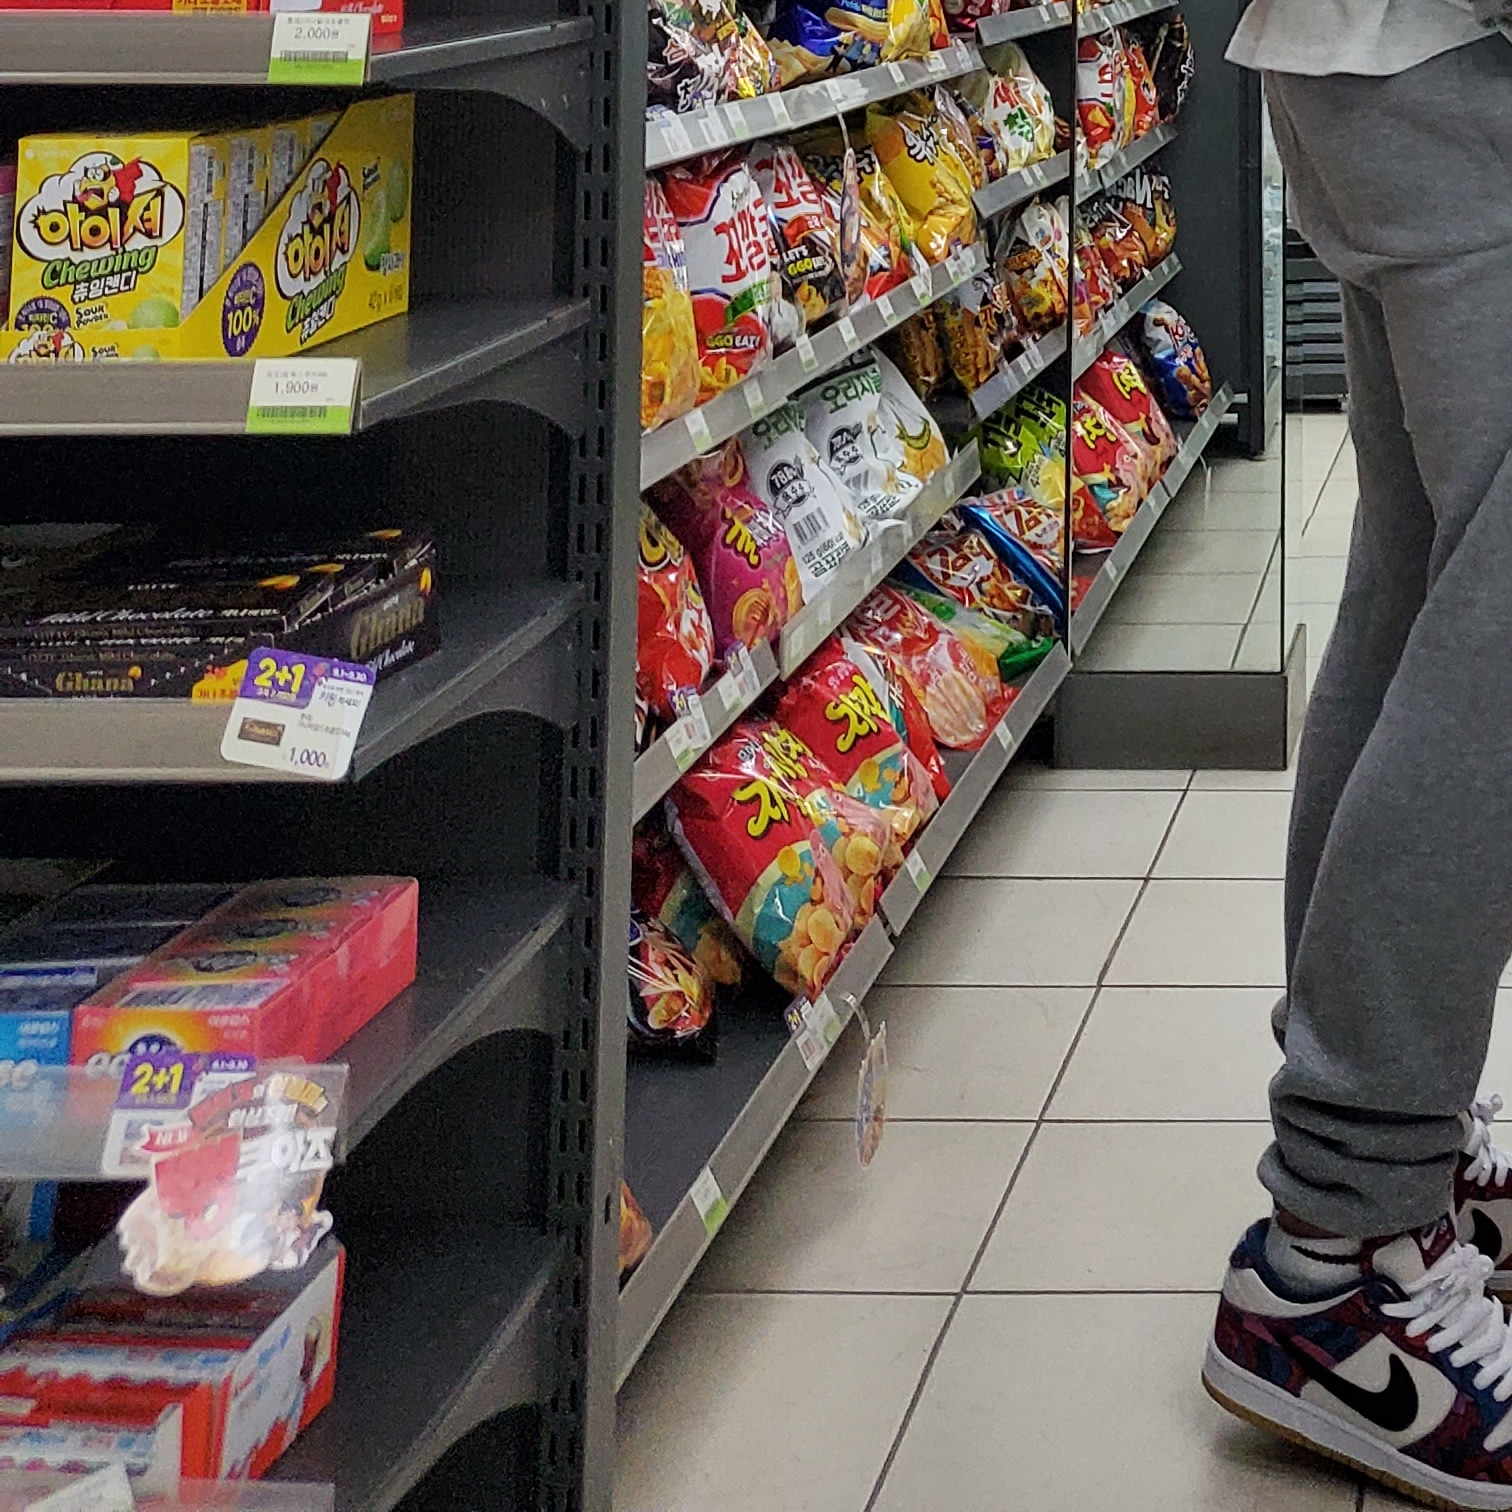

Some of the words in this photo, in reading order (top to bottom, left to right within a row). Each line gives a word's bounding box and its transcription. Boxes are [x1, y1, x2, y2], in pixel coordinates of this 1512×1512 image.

[33, 191, 163, 253] 아이셔
[284, 193, 352, 281] 아이셔
[42, 245, 158, 289] Chewing
[783, 246, 808, 261] LET'S
[787, 261, 812, 276] GGO
[72, 270, 137, 304] 츄잉캔디
[285, 263, 347, 333] Chewing
[254, 657, 306, 694] 2+1
[132, 1063, 184, 1094] 2+1
